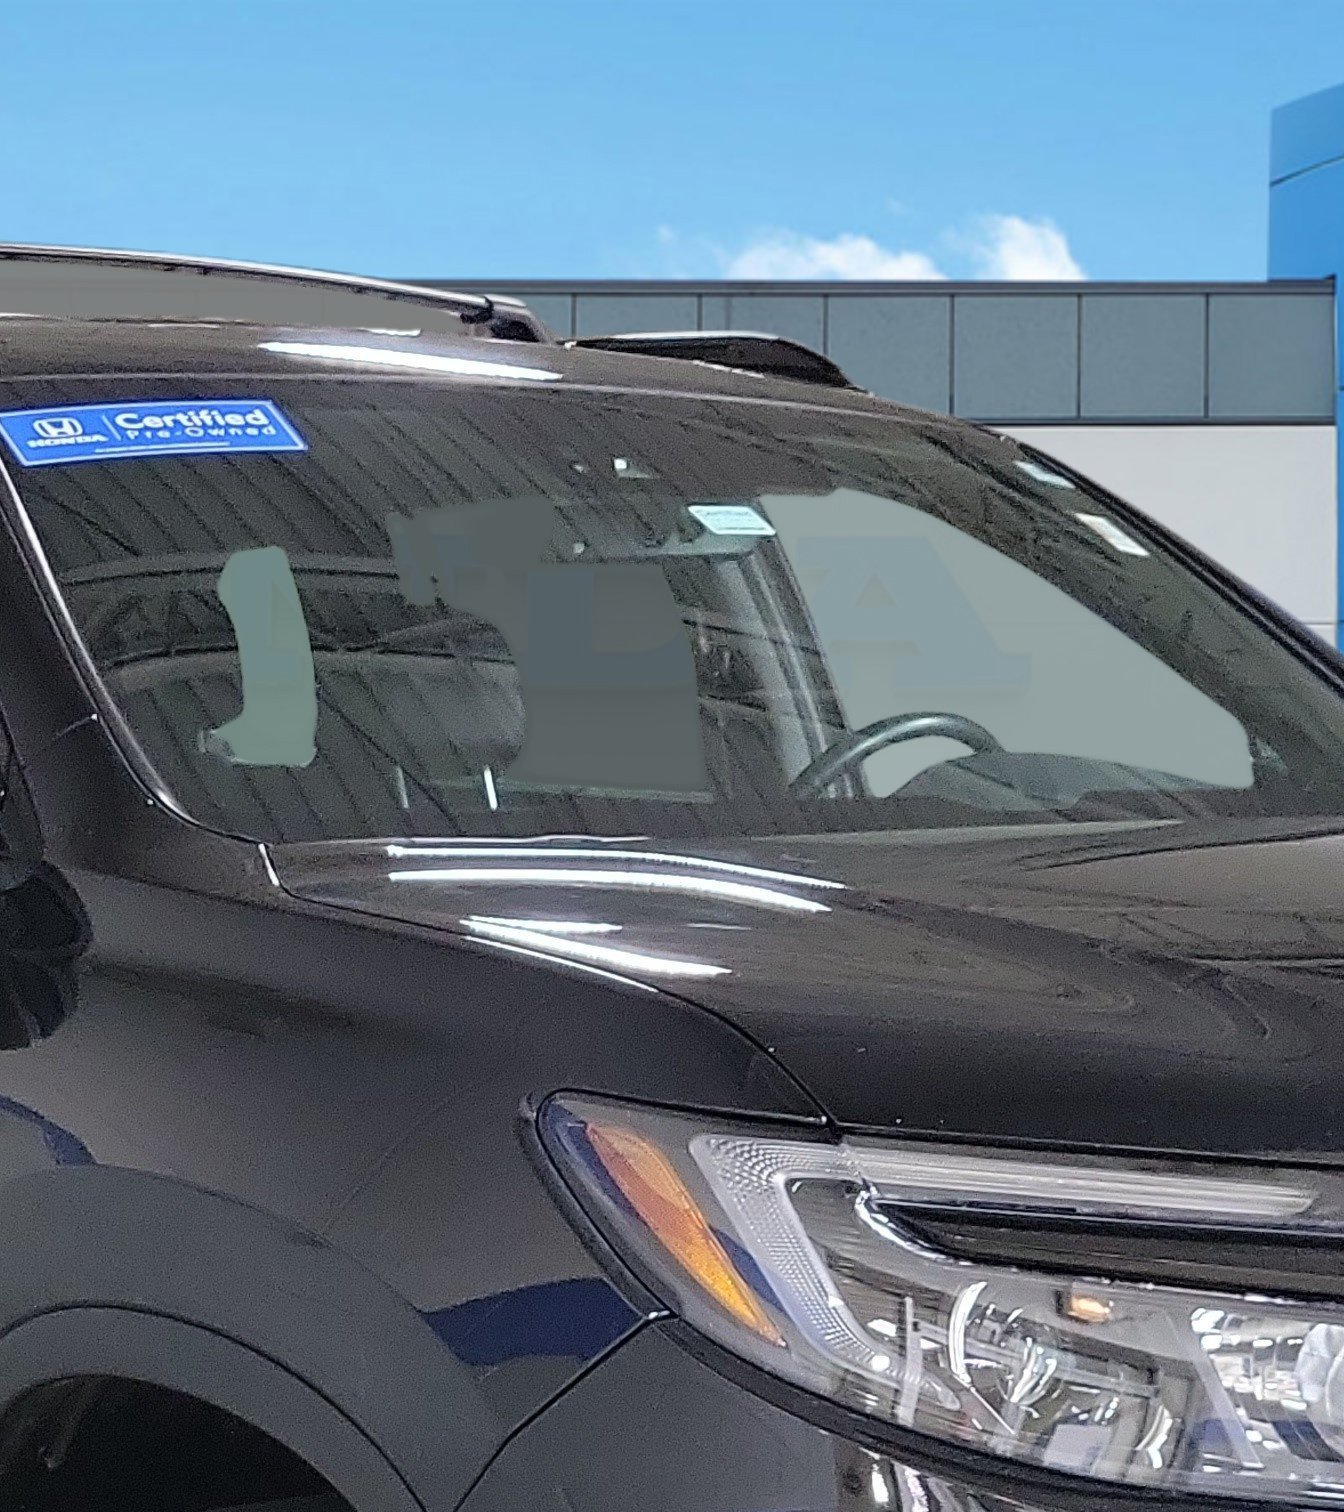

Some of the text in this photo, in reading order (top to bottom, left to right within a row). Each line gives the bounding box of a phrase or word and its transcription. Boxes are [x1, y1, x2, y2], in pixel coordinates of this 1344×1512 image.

[115, 408, 270, 429] Certified
[125, 425, 277, 440] Pre-Owned
[27, 434, 109, 448] HONDA
